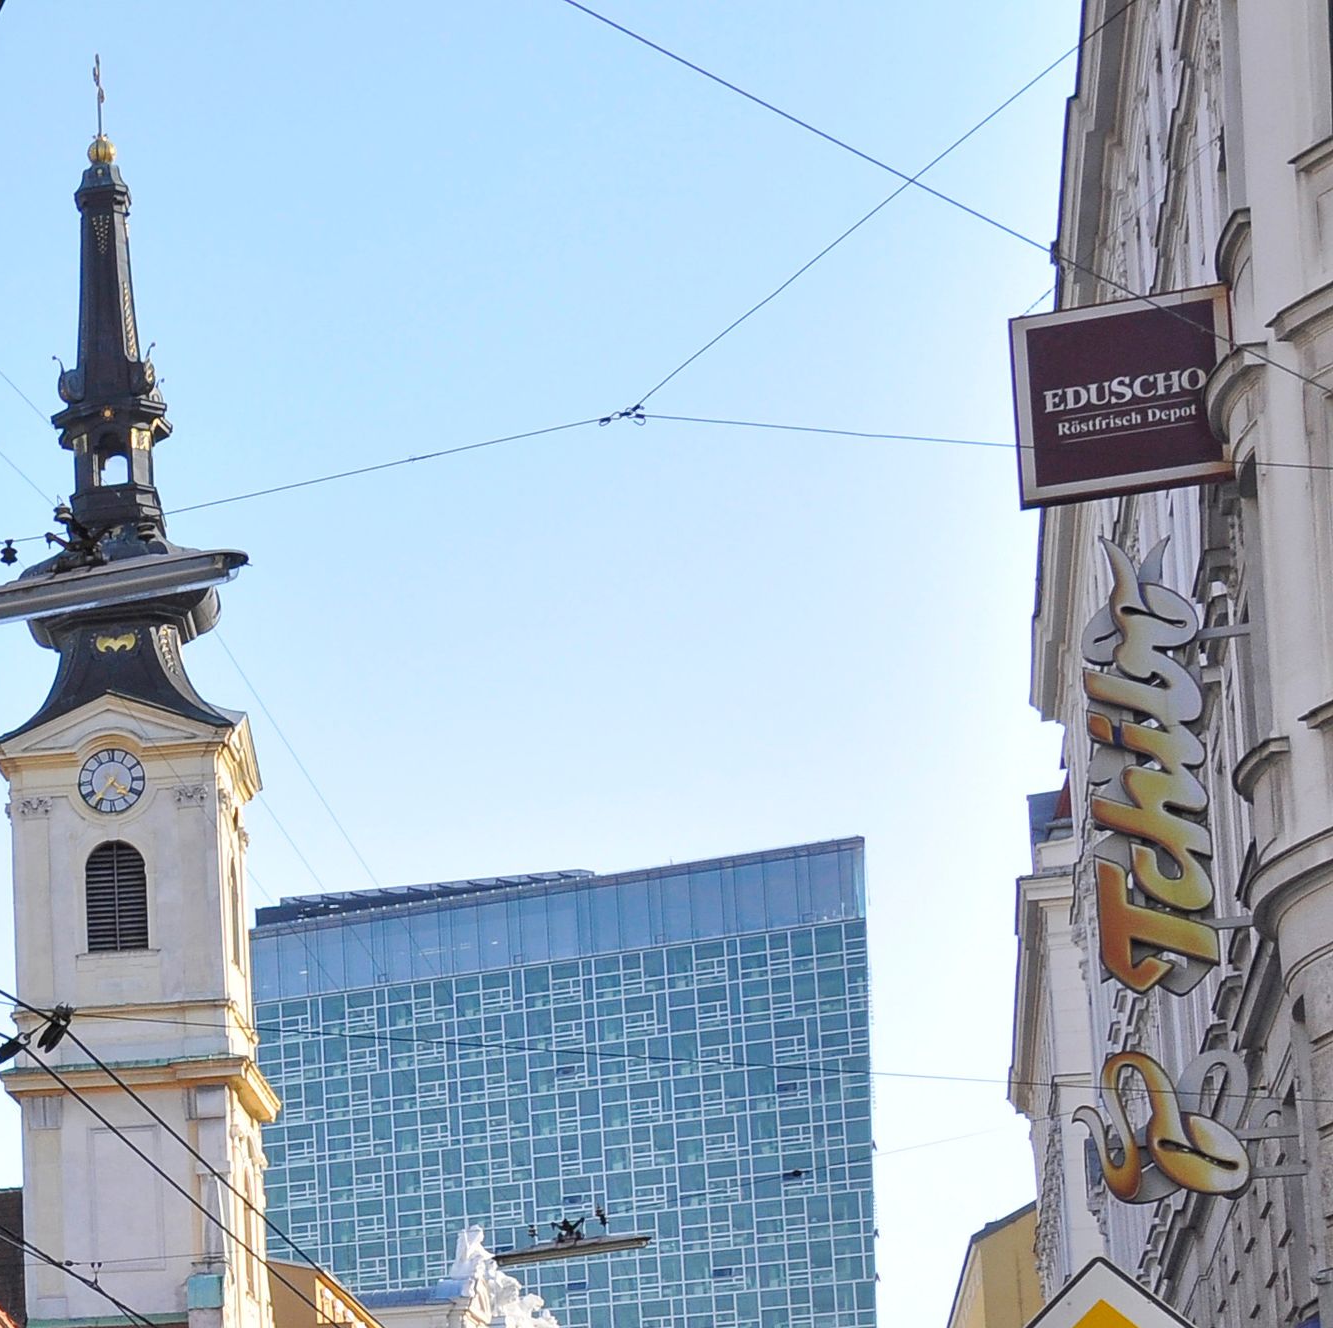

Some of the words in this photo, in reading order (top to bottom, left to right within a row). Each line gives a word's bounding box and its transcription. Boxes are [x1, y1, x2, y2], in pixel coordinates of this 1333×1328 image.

[1043, 367, 1207, 413] EDUSCHO
[1057, 411, 1141, 436] Röstfrisch
[1147, 404, 1197, 424] Depot
